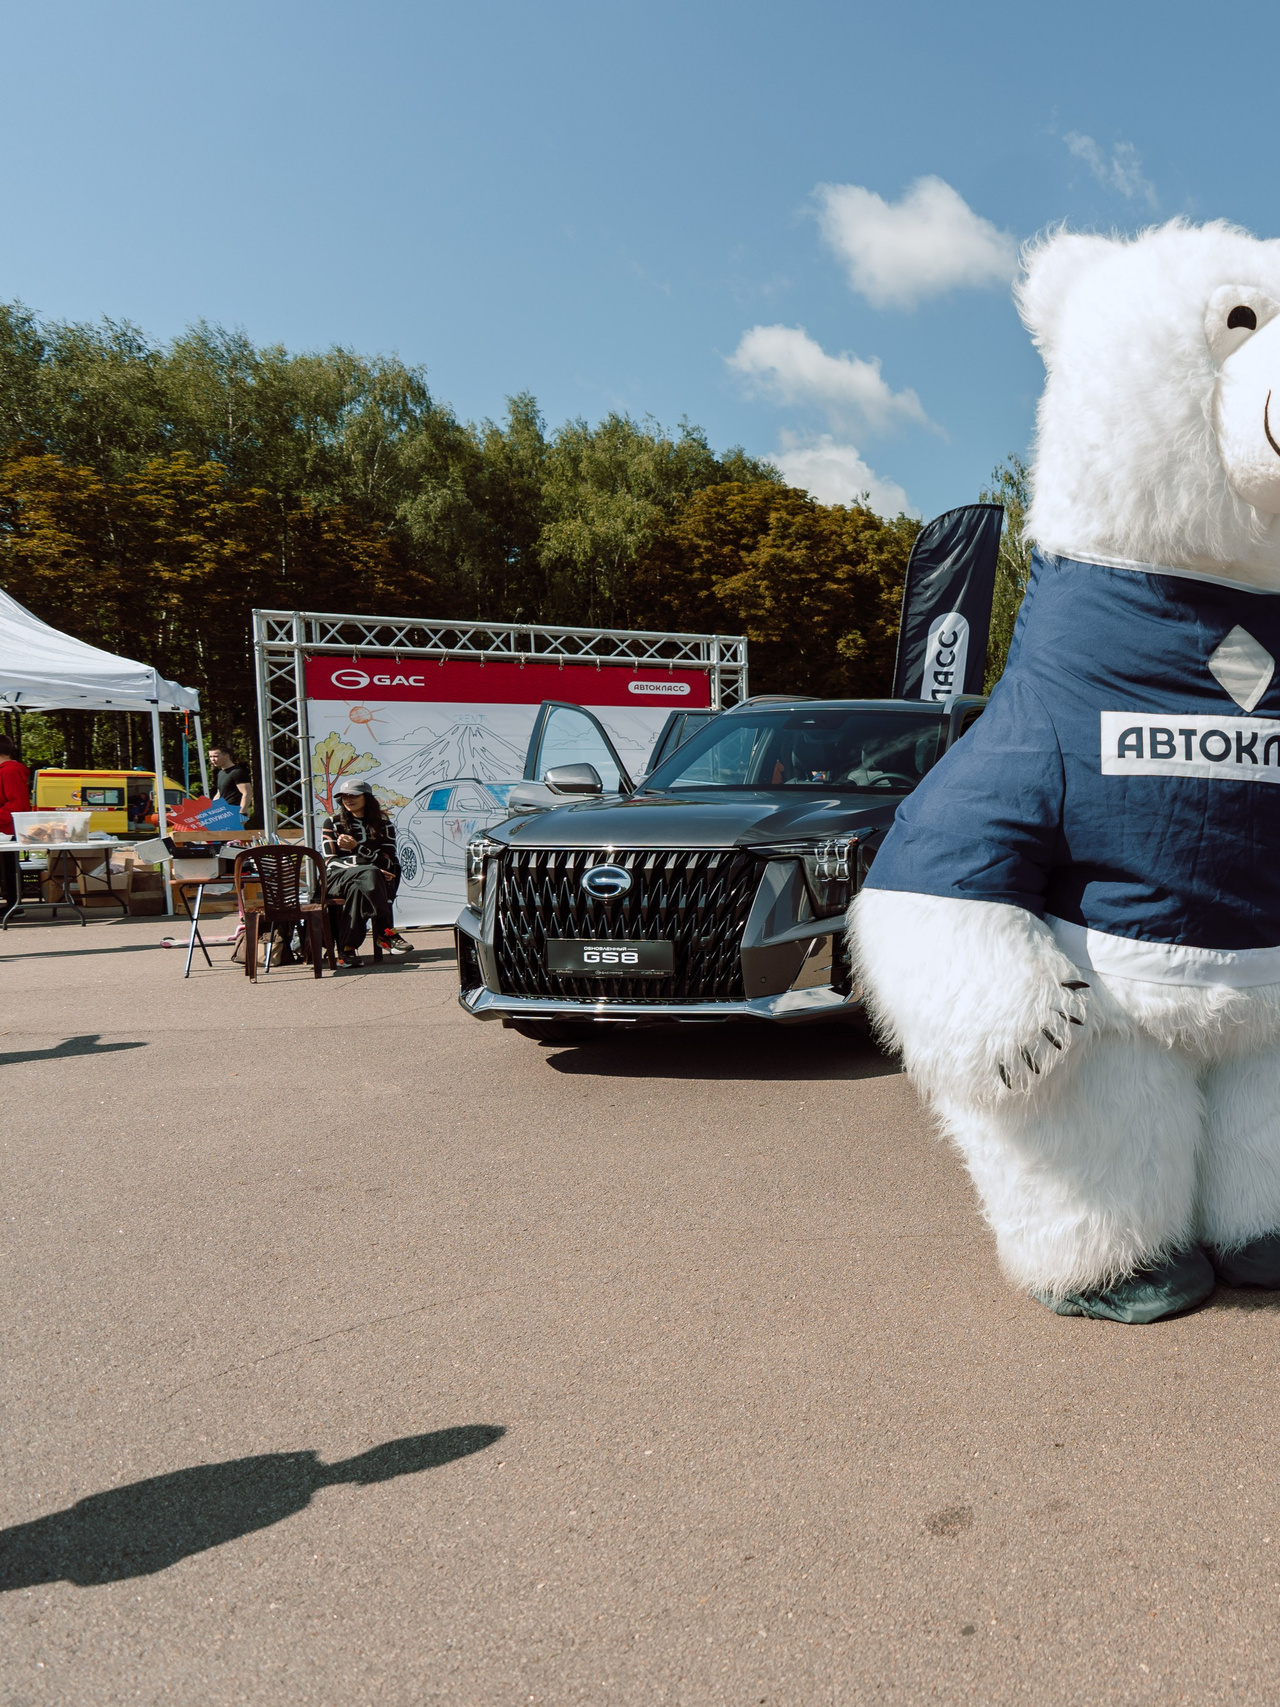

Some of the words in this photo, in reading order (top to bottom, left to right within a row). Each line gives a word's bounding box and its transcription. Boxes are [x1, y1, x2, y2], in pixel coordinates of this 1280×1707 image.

[372, 674, 425, 687] GAC
[633, 684, 685, 692] АВТОКЛАСС
[583, 951, 639, 964] GS8
